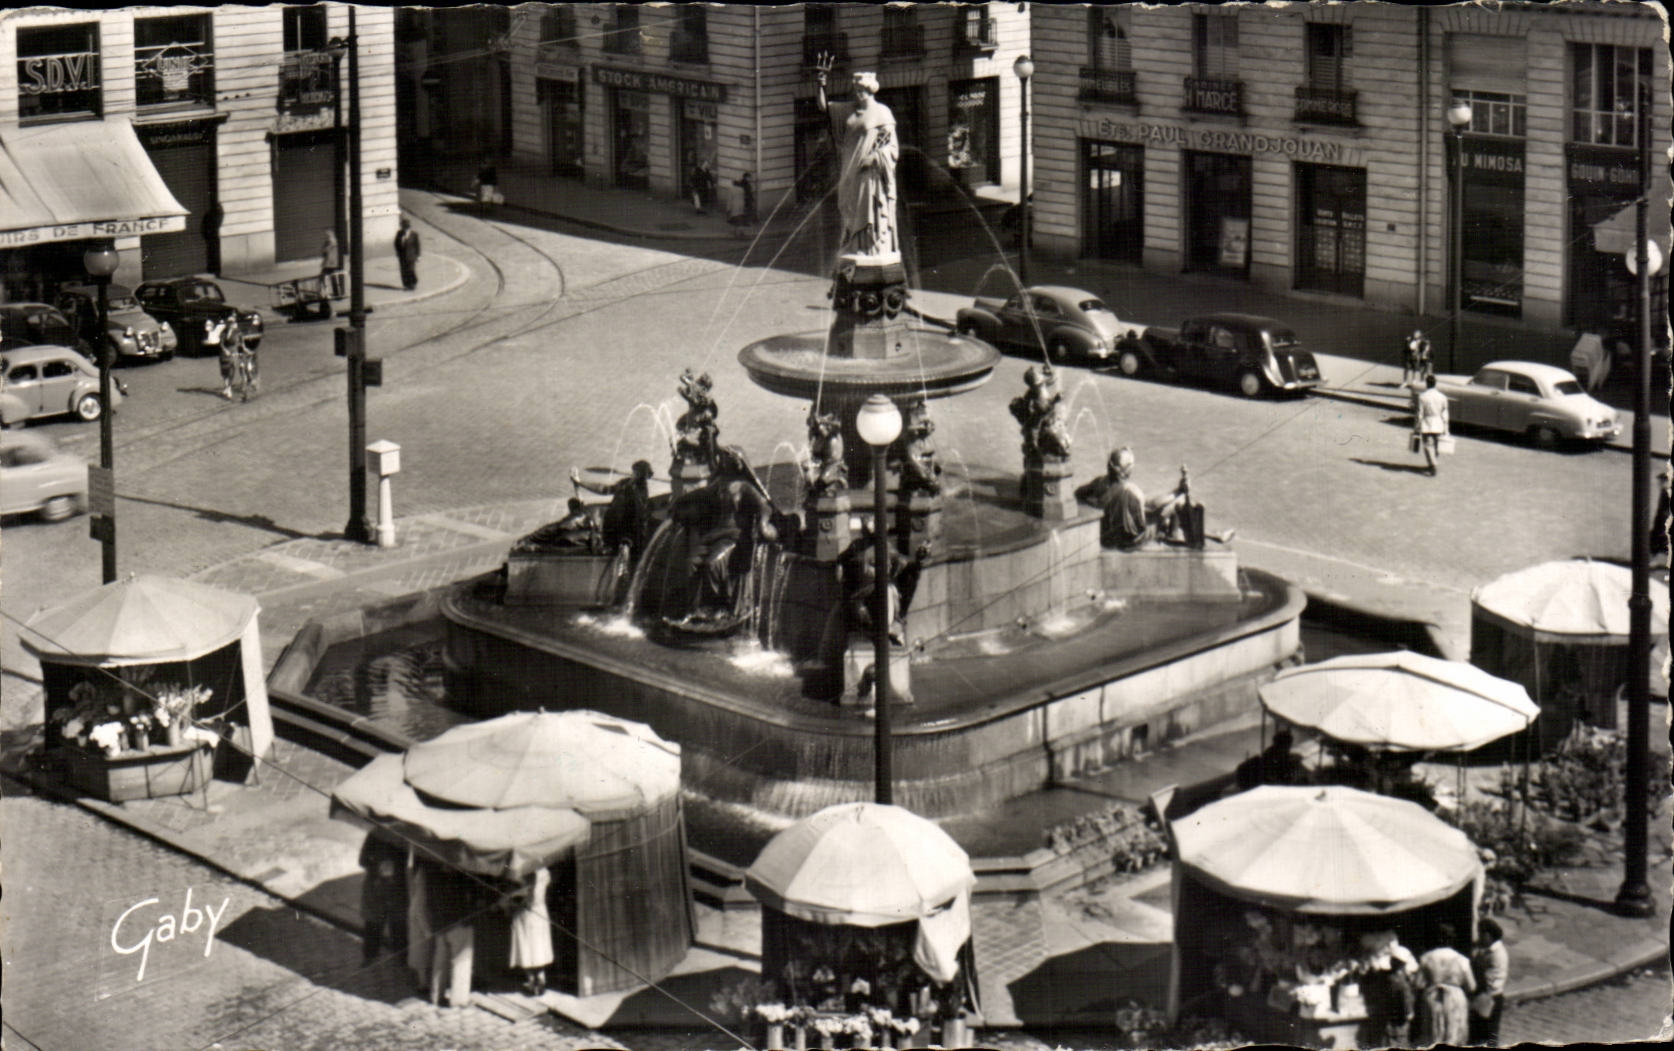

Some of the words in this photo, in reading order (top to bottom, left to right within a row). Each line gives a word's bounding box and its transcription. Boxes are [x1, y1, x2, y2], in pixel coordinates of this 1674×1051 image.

[598, 70, 641, 88] STOCK
[1137, 124, 1187, 145] PAUL
[1200, 131, 1341, 160] GRANDJOUAN
[1474, 153, 1522, 173] MIMOSA
[53, 225, 78, 238] DE
